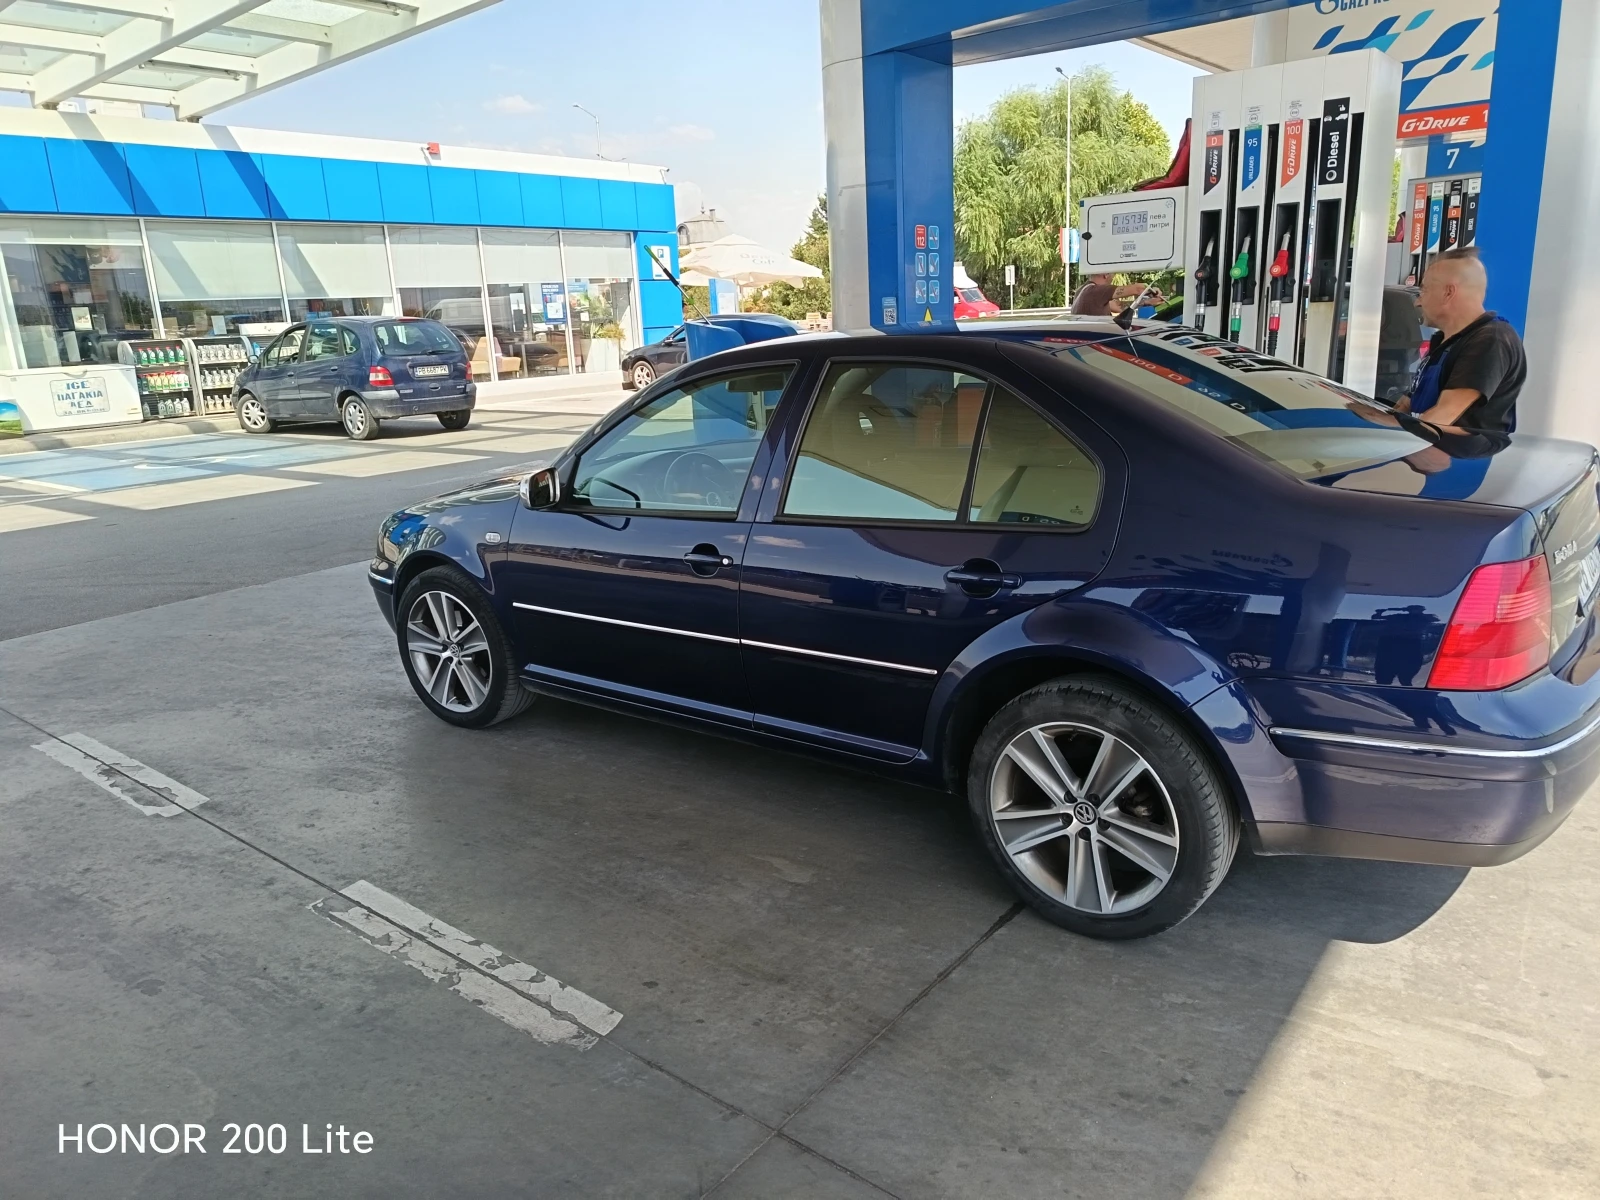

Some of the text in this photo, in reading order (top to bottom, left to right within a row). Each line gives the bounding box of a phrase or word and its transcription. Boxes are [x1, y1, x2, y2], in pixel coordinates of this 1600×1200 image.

[1286, 125, 1301, 135] 100
[1211, 137, 1218, 146] D
[1247, 138, 1258, 147] 95
[1327, 131, 1340, 168] Diesel
[1446, 148, 1460, 170] 7
[916, 236, 925, 246] 112
